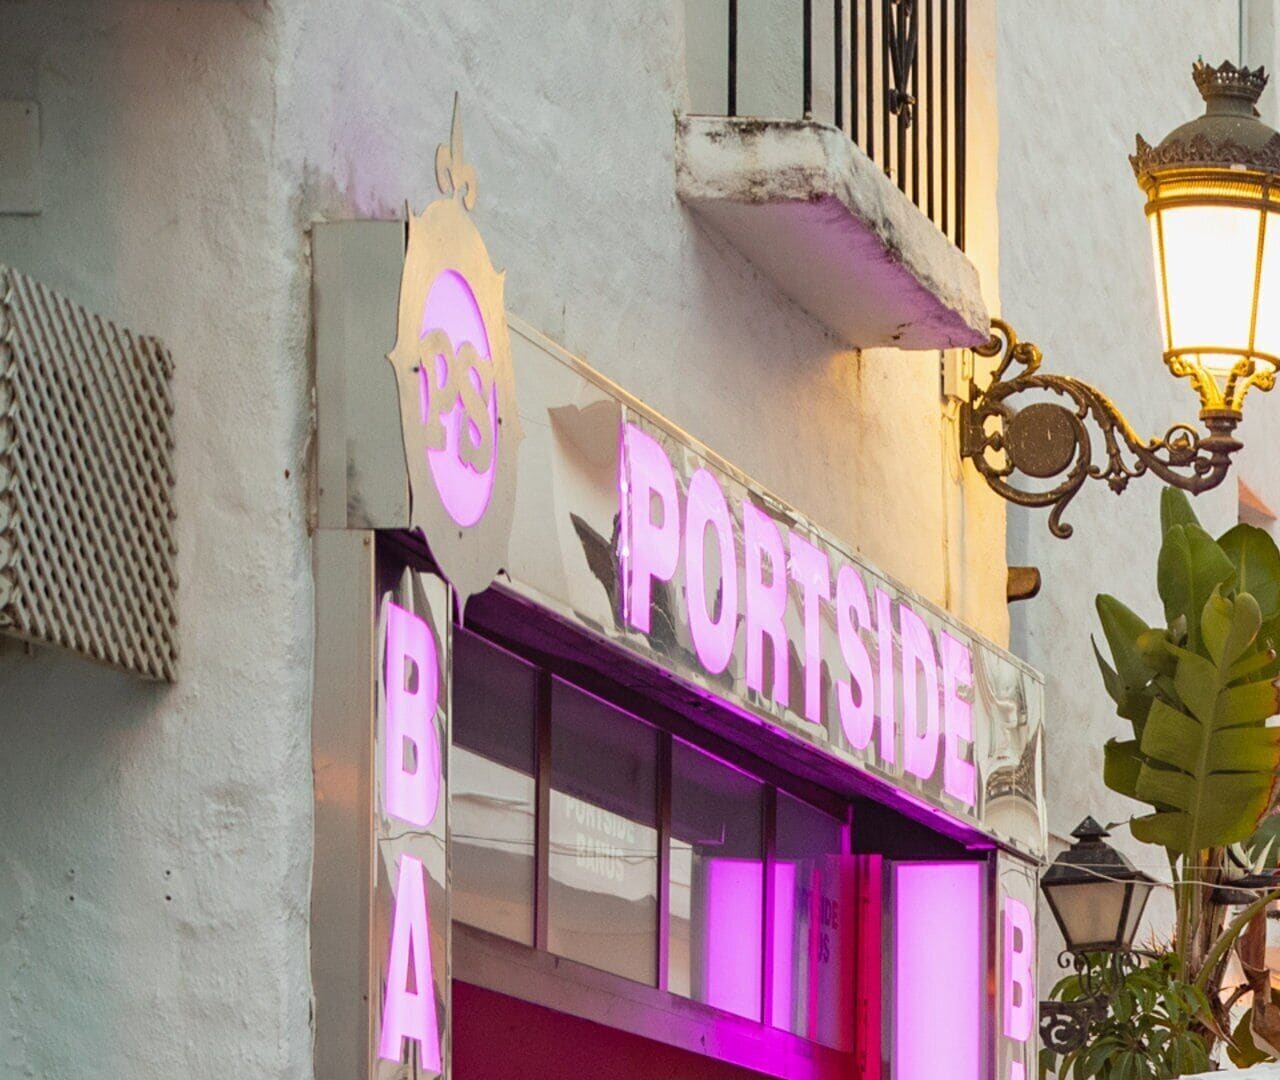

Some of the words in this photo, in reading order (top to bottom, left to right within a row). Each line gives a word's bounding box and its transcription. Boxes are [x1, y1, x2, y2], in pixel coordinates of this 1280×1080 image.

[621, 422, 976, 807] PORTSIDE
[564, 797, 636, 844] PORTSIDE
[576, 831, 625, 881] BANUS
